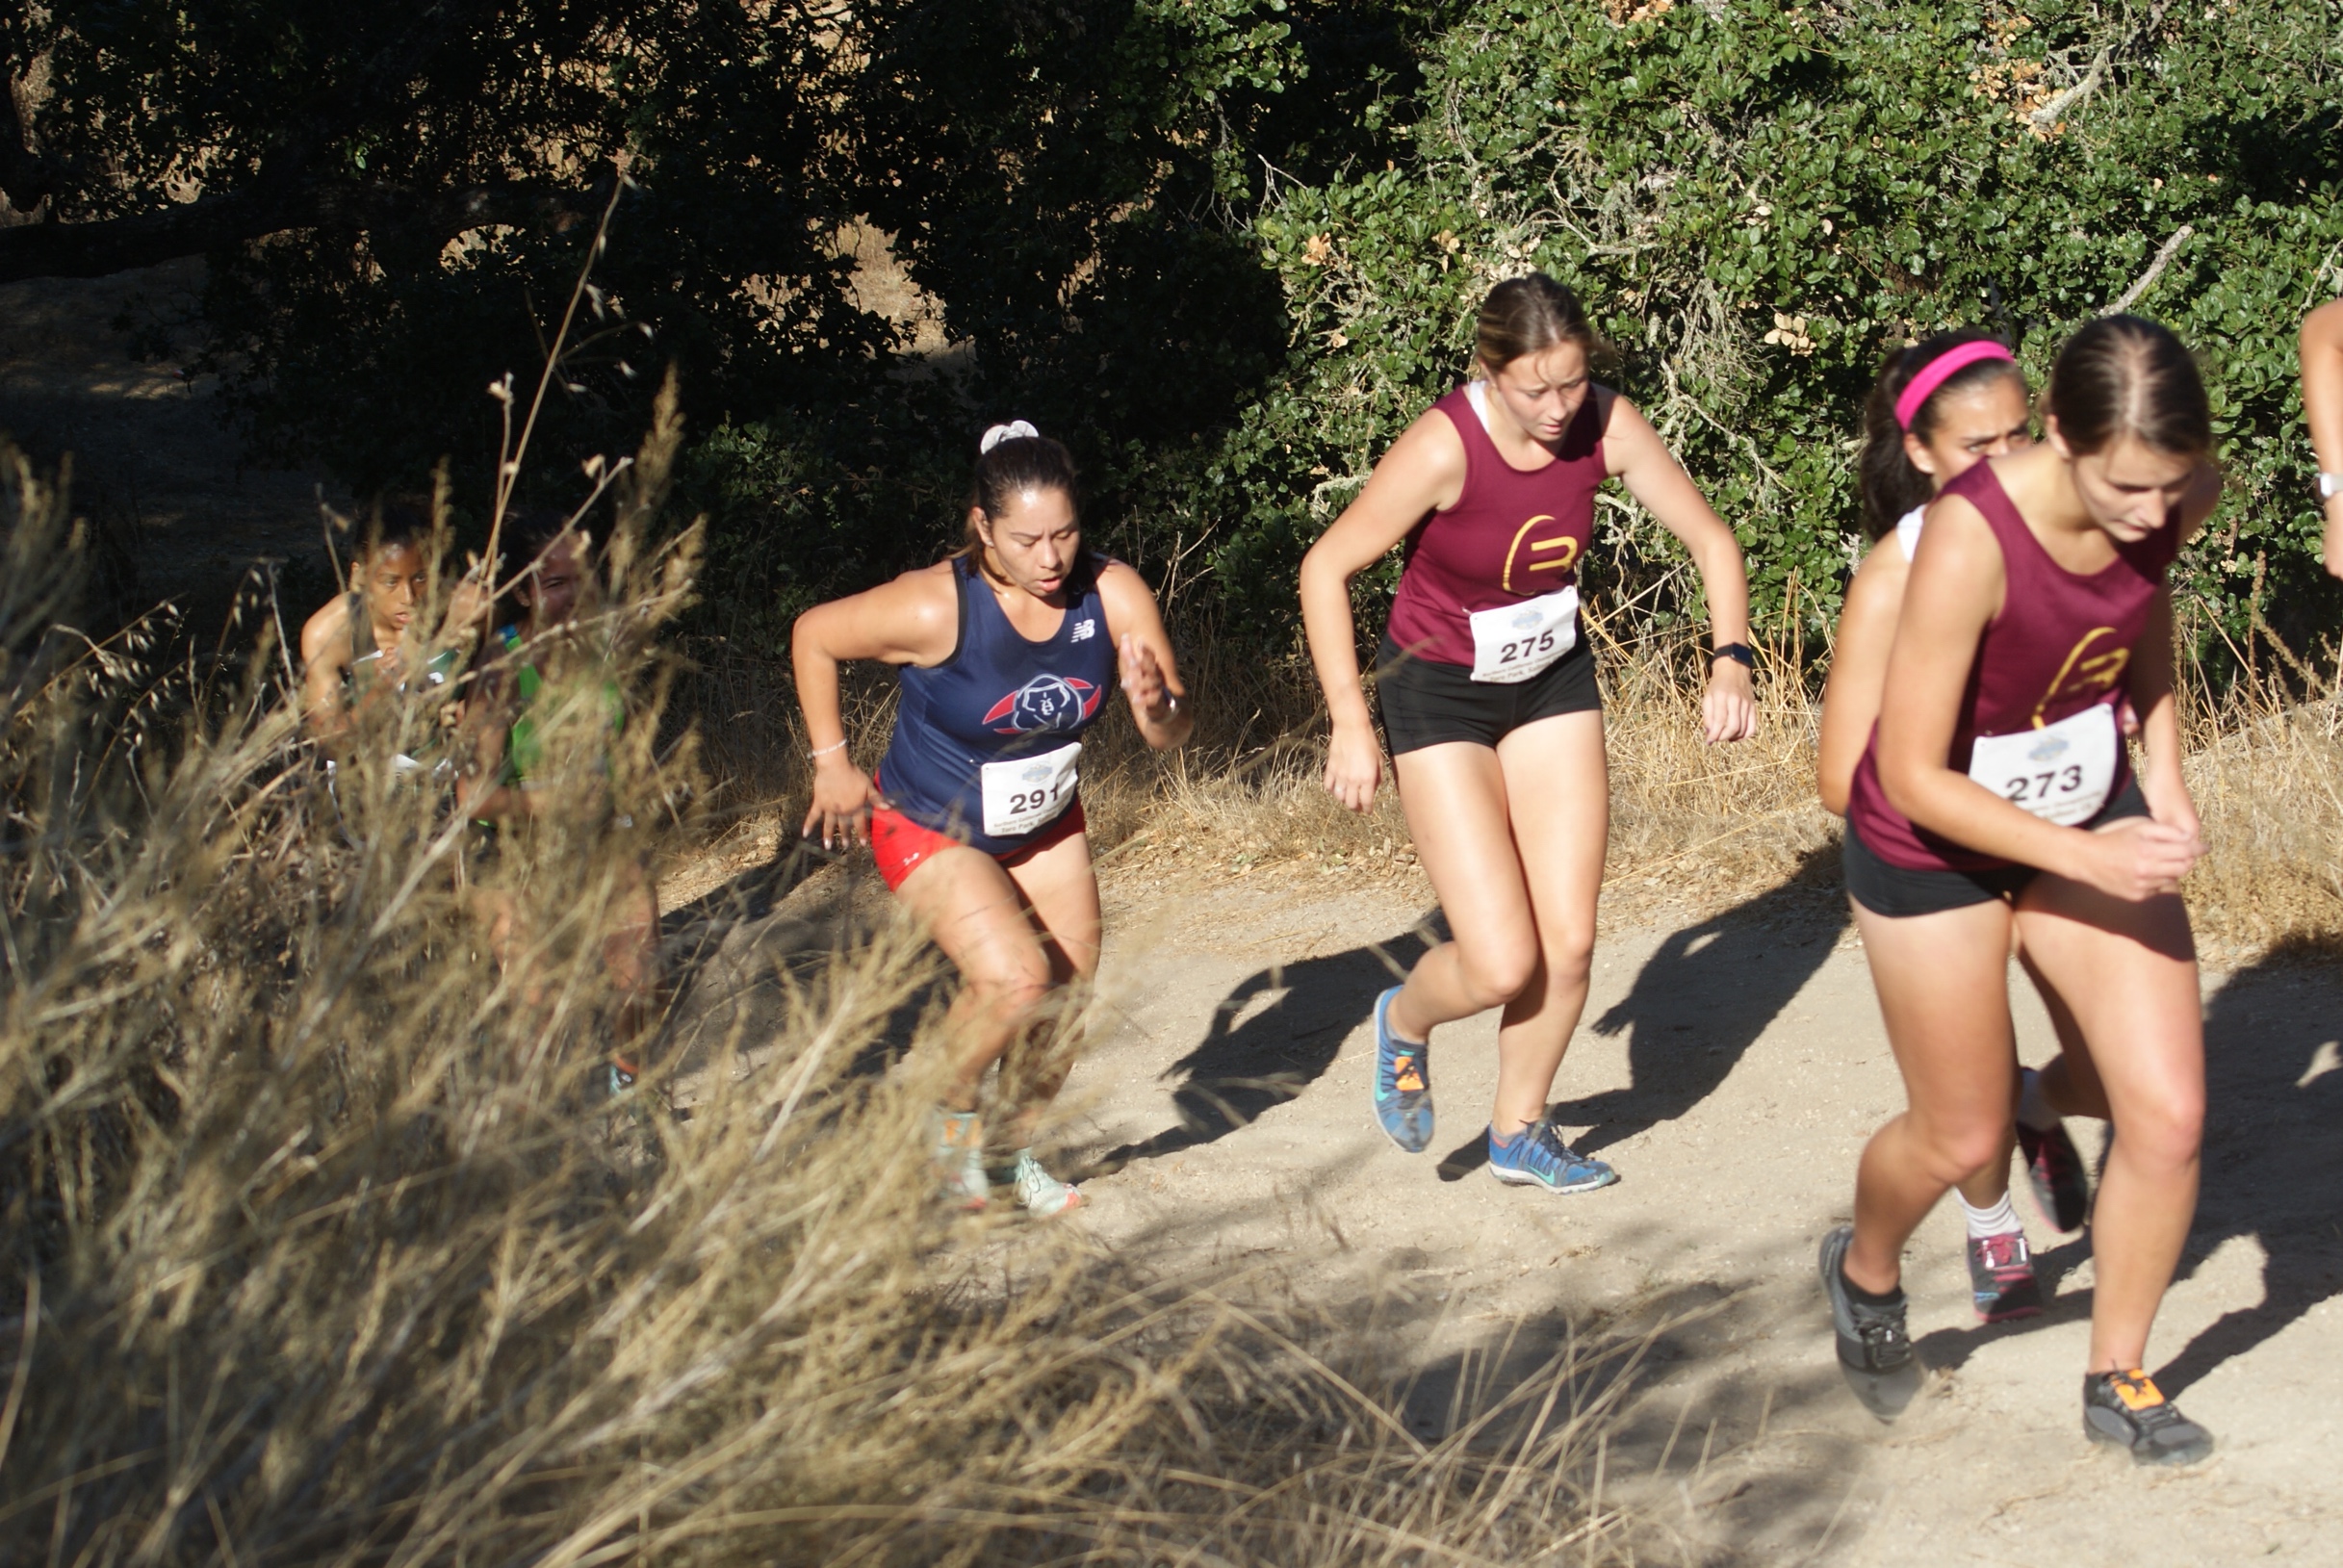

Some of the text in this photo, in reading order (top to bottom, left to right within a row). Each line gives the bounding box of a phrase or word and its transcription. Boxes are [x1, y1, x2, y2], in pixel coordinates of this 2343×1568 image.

[1500, 630, 1555, 664] 275
[1010, 783, 1060, 815] 291
[2006, 765, 2083, 802] 273
